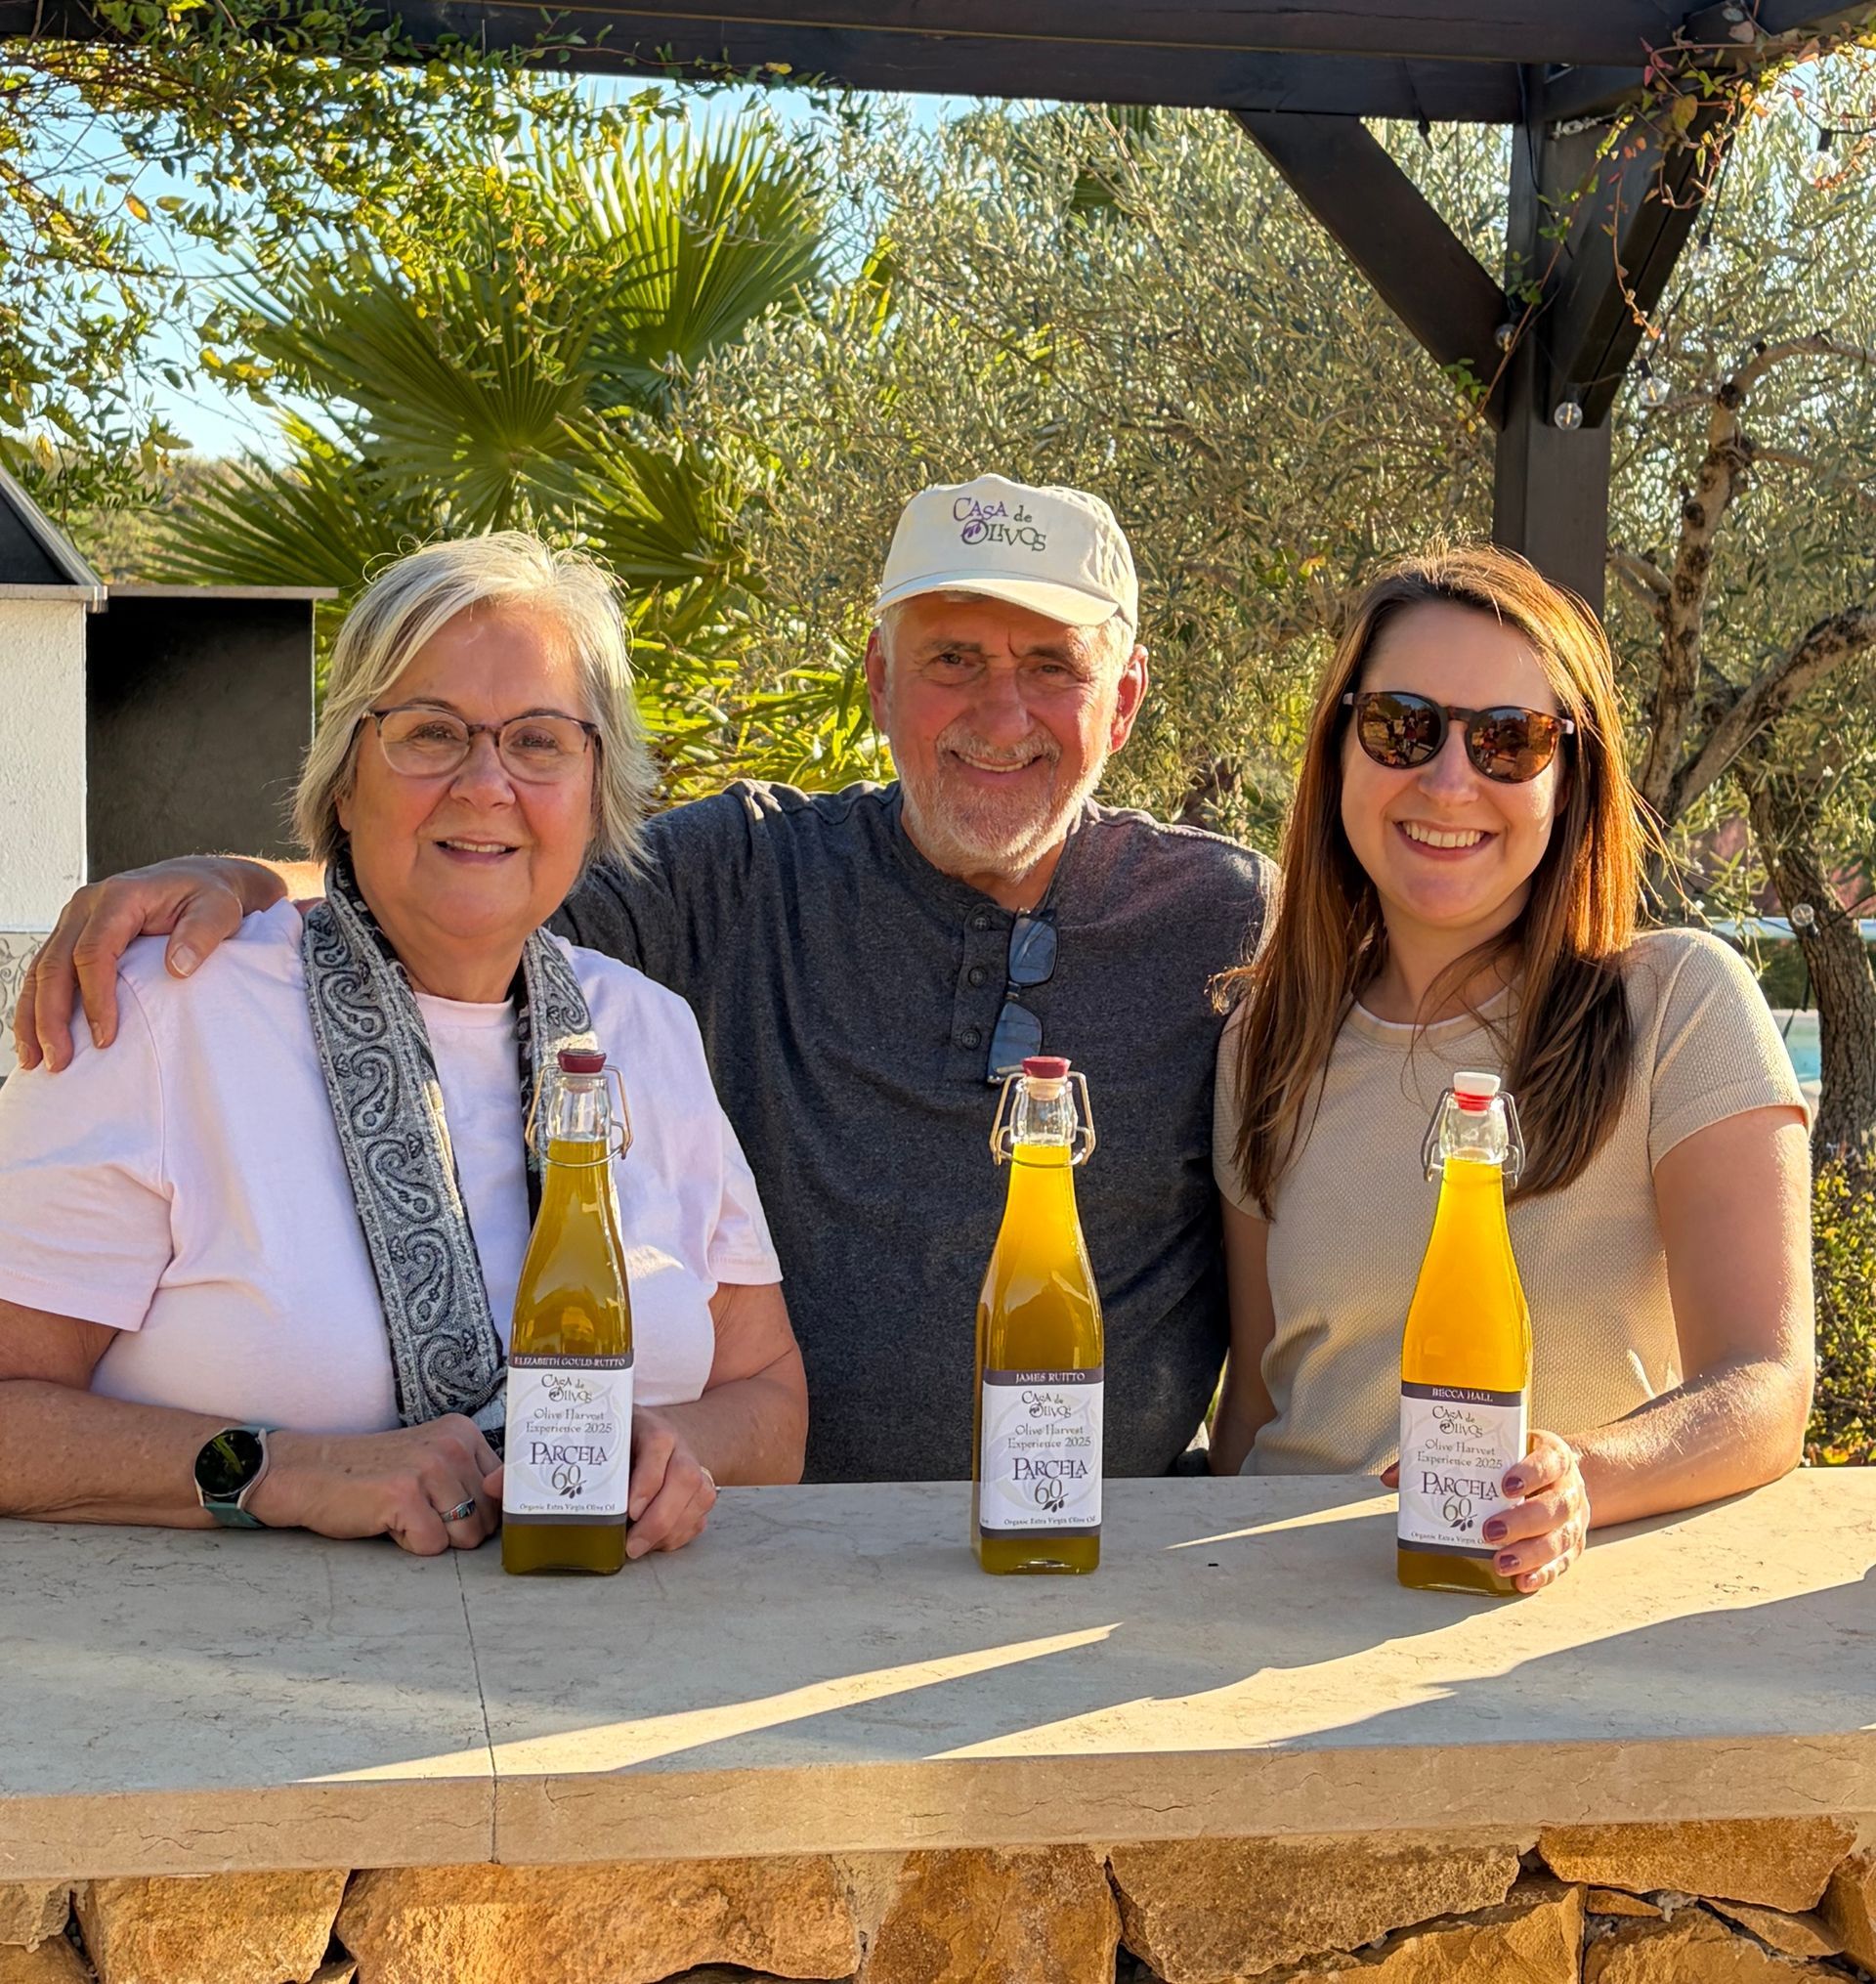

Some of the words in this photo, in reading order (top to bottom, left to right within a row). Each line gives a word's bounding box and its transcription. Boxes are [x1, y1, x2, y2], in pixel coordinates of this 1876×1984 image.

[1013, 504, 1033, 523] de
[514, 1357, 560, 1366] ELIZABETH
[575, 1378, 585, 1389] de
[1015, 1372, 1046, 1384] JAMES
[1053, 1394, 1064, 1404] de
[1431, 1387, 1465, 1400] BECCA
[1467, 1391, 1493, 1402] HALL
[533, 1406, 563, 1420] Olive
[565, 1407, 604, 1420] Harvest
[1465, 1412, 1475, 1423] de
[526, 1421, 581, 1436] Experience
[584, 1422, 613, 1434] 2025
[1015, 1422, 1043, 1436] Olive
[1045, 1423, 1084, 1435] Harvest
[1007, 1437, 1062, 1451] Experience
[1065, 1437, 1091, 1447] 2025
[1425, 1438, 1453, 1452] Olive
[1456, 1441, 1495, 1456] Harvest
[1417, 1450, 1471, 1467] Experience
[1475, 1456, 1503, 1470] 2025
[551, 1463, 581, 1490] 60
[1034, 1478, 1063, 1505] 60
[1442, 1495, 1471, 1522] 60
[1003, 1517, 1028, 1527] Organic
[1030, 1517, 1046, 1526] Extra
[1048, 1516, 1067, 1526] Virgin
